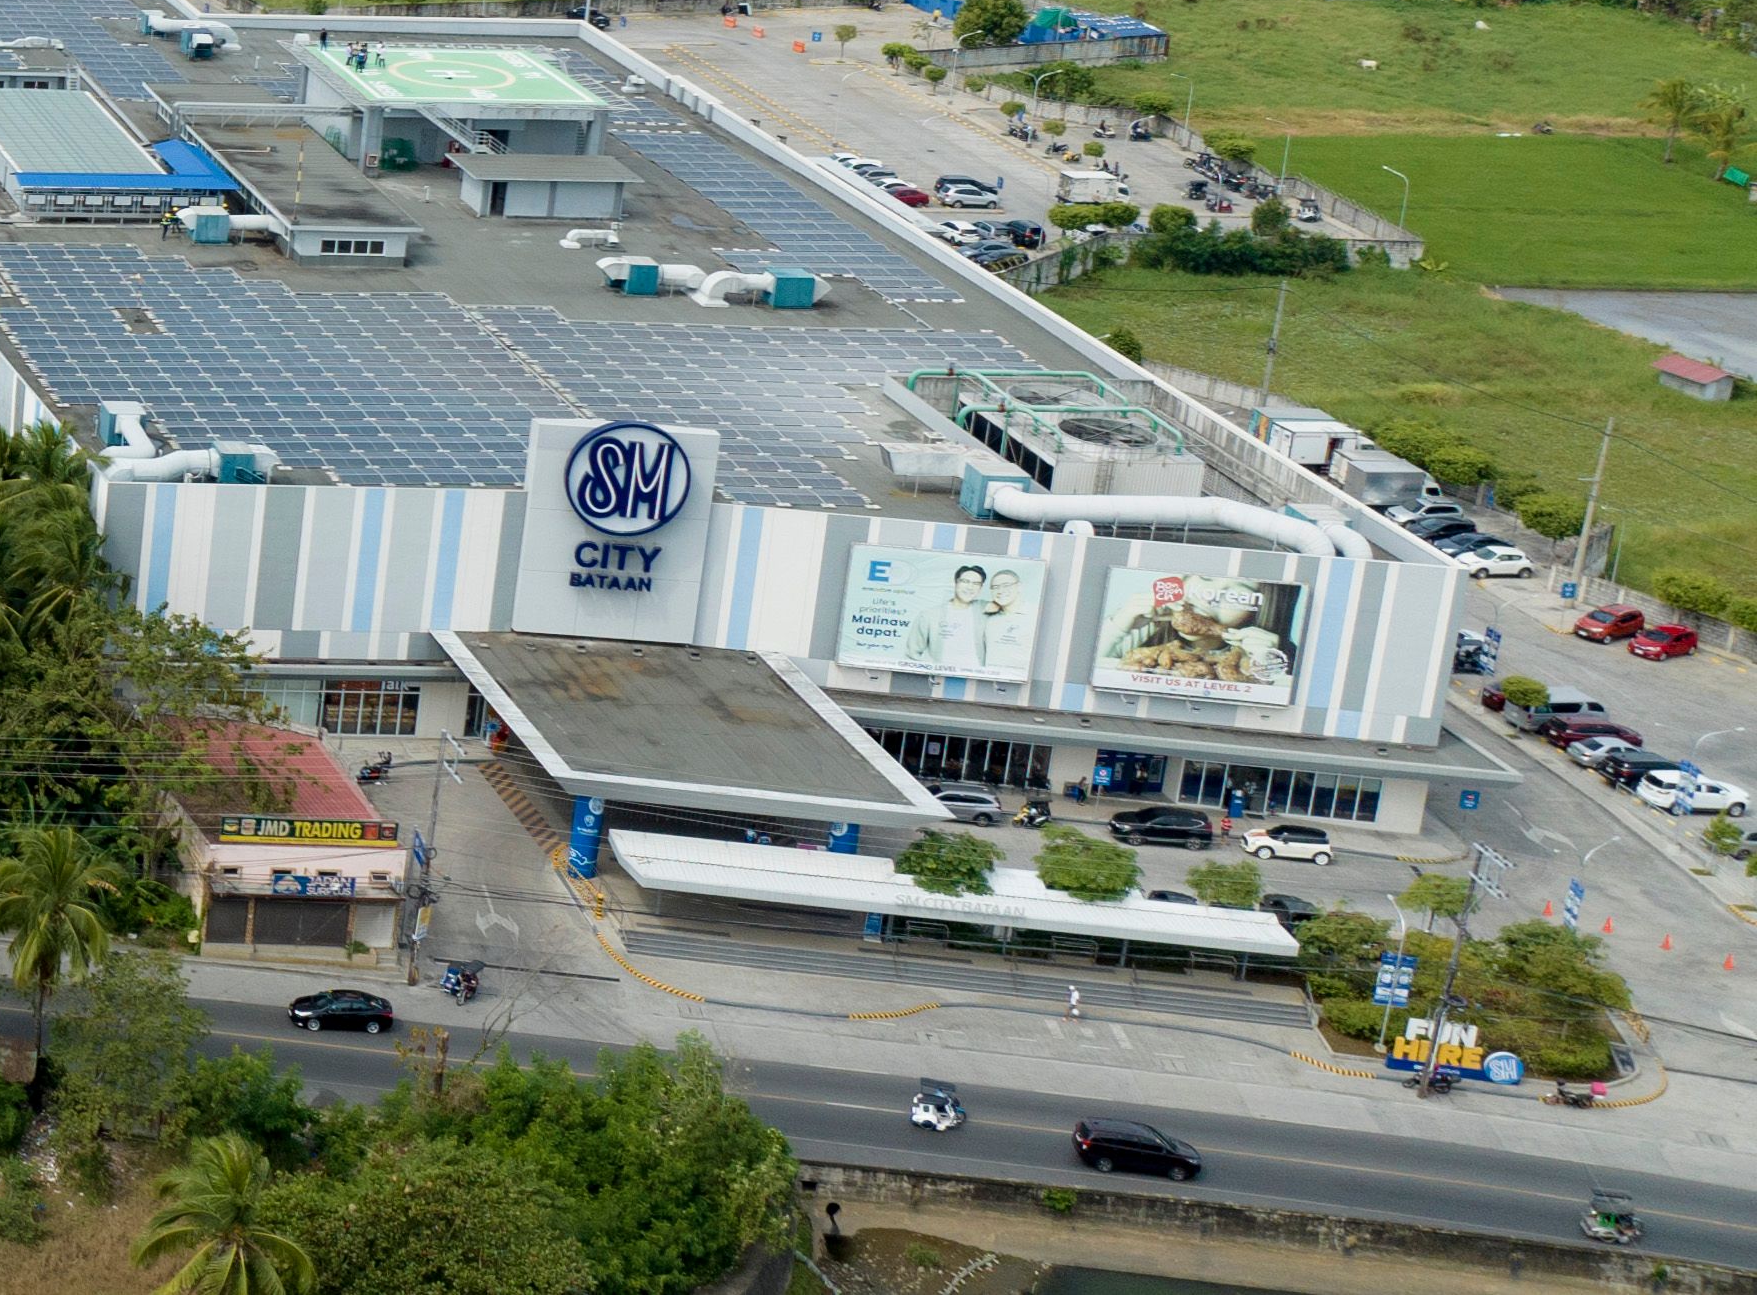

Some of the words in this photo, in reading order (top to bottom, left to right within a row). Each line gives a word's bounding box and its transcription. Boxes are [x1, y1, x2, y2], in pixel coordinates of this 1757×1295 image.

[577, 436, 675, 521] SM
[575, 541, 662, 573] CITY
[570, 572, 652, 591] BATAAN
[872, 597, 897, 606] Life's
[1189, 586, 1264, 606] Korean
[859, 606, 907, 616] priorities?
[851, 614, 911, 627] Malinaw
[856, 625, 901, 638] dapat.
[898, 660, 933, 671] GROUND
[934, 664, 957, 672] LEVEL
[1131, 674, 1162, 685] VISIT
[1166, 678, 1181, 687] US
[1185, 680, 1203, 690] AT
[1204, 682, 1241, 693] LEVEL
[1244, 685, 1253, 693] 2
[257, 821, 290, 837] JMD
[293, 821, 362, 839] TRADING
[307, 877, 351, 888] JAPAN
[1405, 1017, 1478, 1049] FUN
[1488, 1058, 1518, 1080] SM
